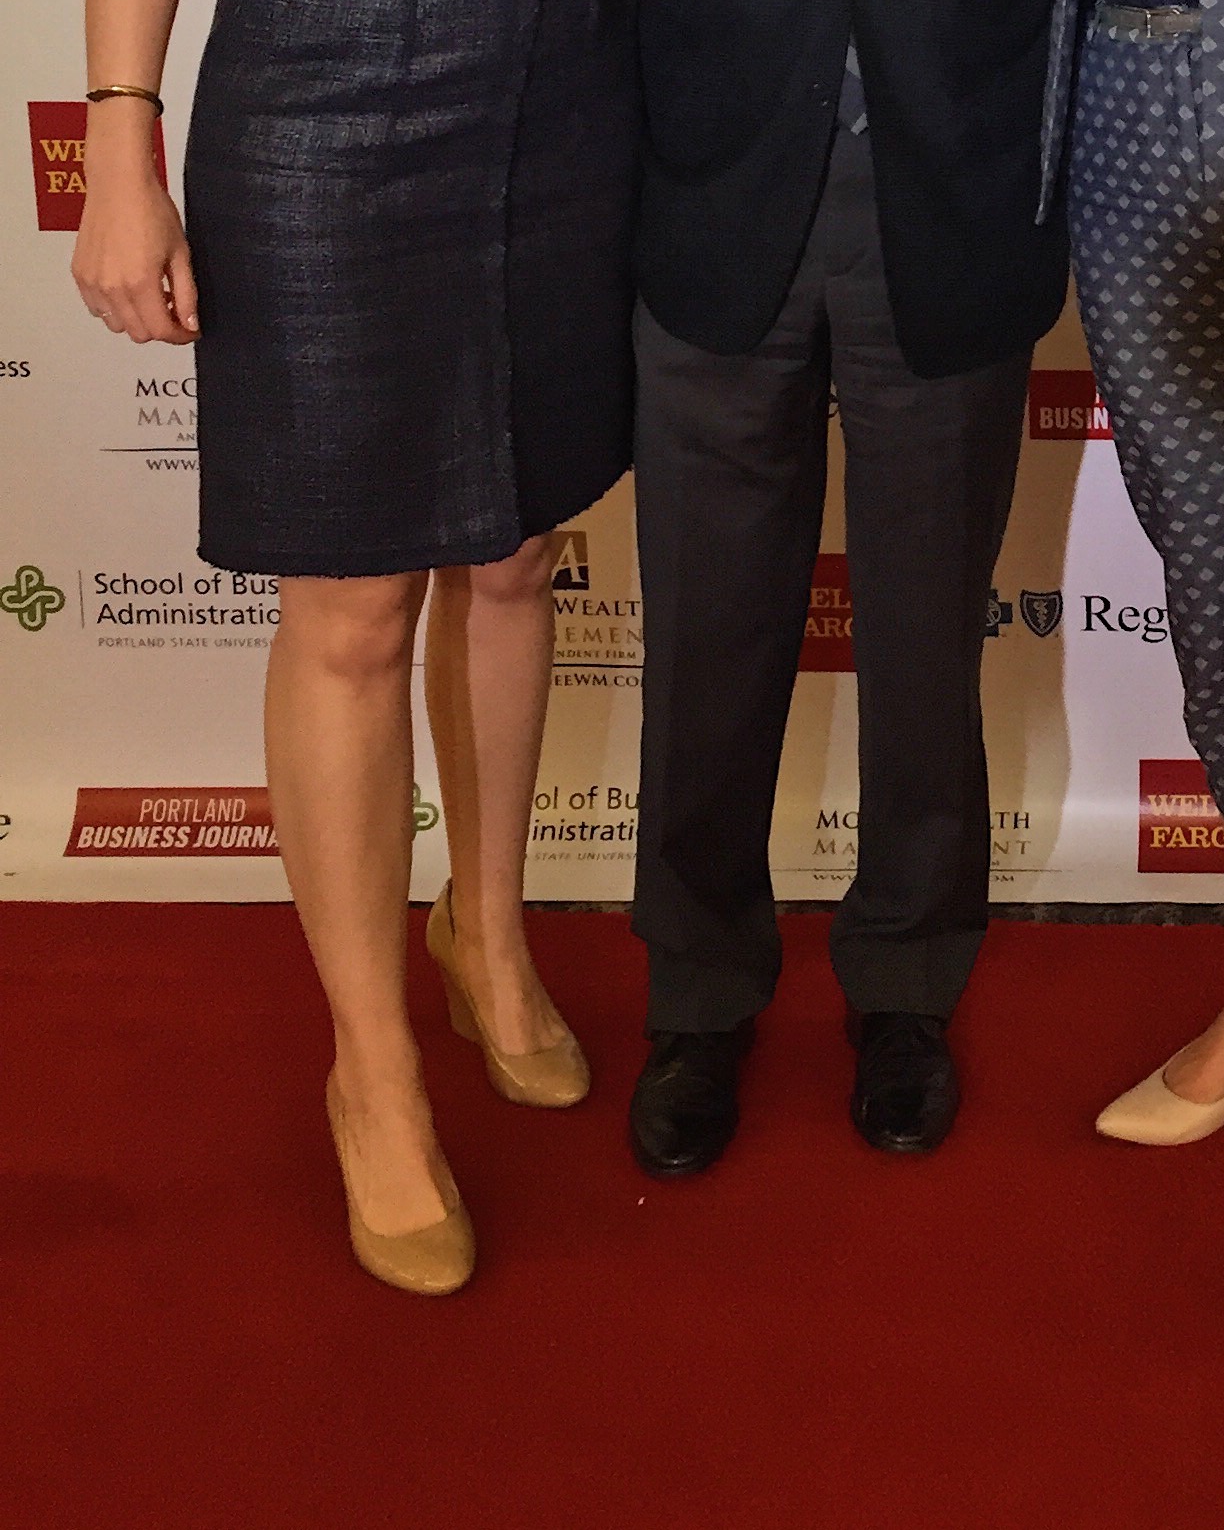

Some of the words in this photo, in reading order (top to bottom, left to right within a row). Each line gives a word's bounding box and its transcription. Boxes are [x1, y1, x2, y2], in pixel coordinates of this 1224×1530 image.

[1040, 407, 1109, 429] BUSIN
[95, 573, 183, 594] School
[194, 573, 221, 594] of
[97, 603, 282, 625] Administratio
[554, 597, 640, 617] WEALT
[98, 637, 165, 648] PORTLAND
[170, 638, 207, 647] STATE
[214, 638, 270, 648] UNIVERS
[569, 786, 598, 809] of
[139, 798, 246, 823] PORTLAND
[77, 826, 191, 848] BUSINESS
[194, 826, 279, 848] JOURNA
[532, 819, 636, 841] inistrati
